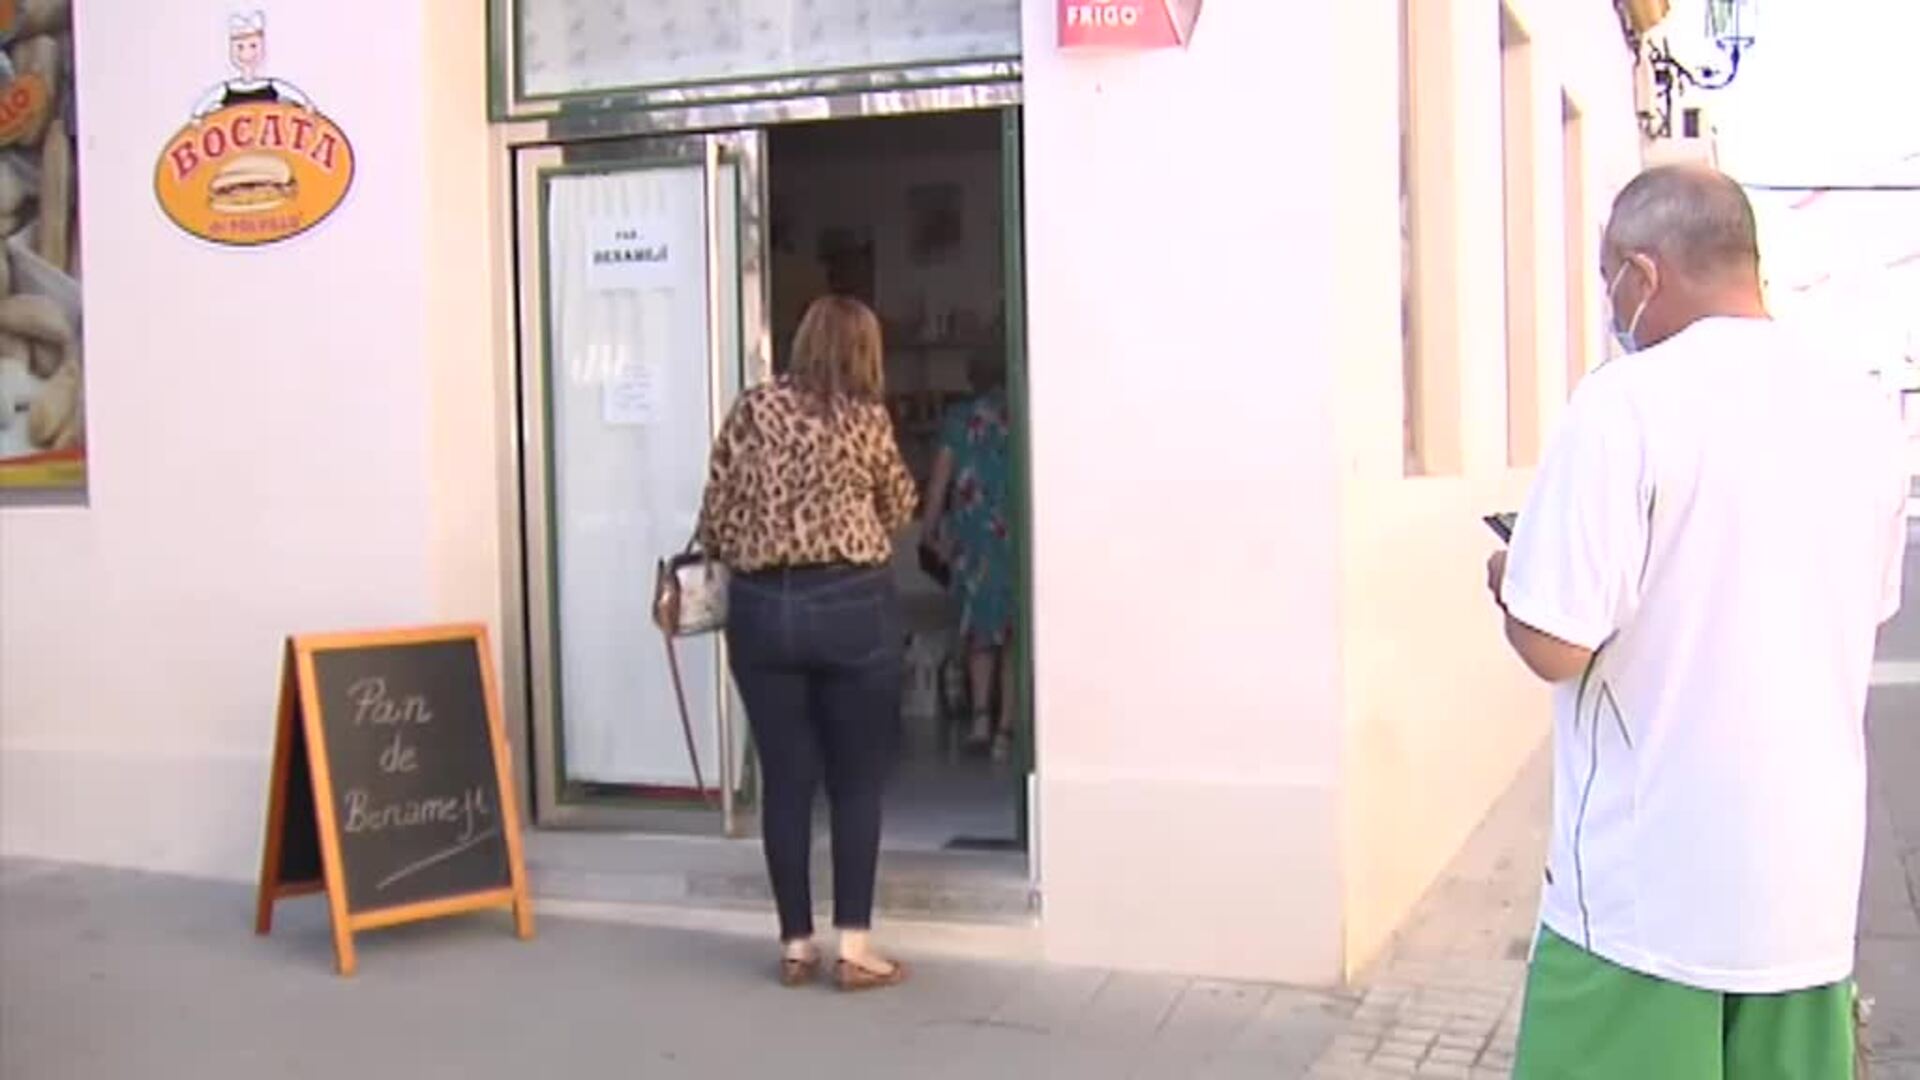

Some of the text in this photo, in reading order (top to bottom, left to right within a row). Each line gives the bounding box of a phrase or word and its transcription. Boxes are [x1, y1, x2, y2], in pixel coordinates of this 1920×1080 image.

[1066, 5, 1137, 27] FRIGO
[171, 114, 336, 180] BOCATA
[347, 675, 433, 725] Pan
[379, 731, 419, 773] de
